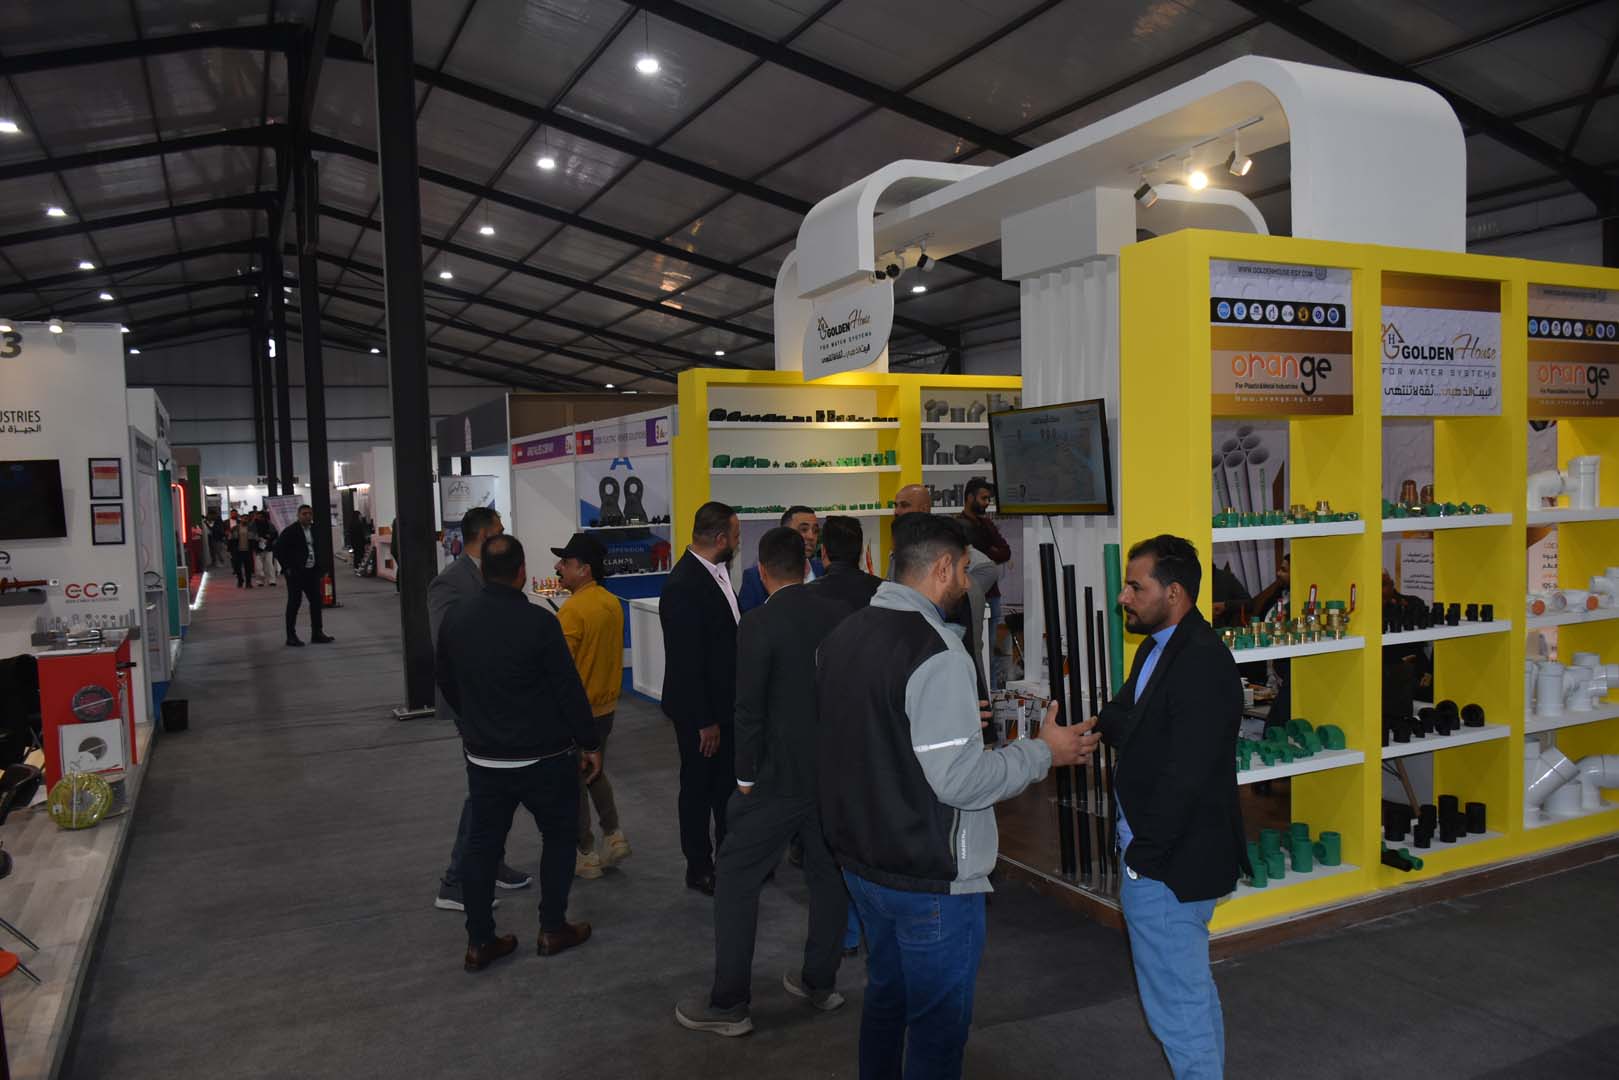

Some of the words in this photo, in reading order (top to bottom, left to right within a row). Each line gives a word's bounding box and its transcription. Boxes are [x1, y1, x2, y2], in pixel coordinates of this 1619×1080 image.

[826, 323, 850, 338] GOLDEN
[1401, 345, 1454, 360] GOLDEN
[1453, 333, 1496, 360] House
[1231, 352, 1332, 396] orange
[1381, 367, 1403, 376] FOR
[1409, 368, 1444, 377] WATER
[1450, 368, 1497, 379] SYSTEMS
[1538, 364, 1610, 399] orange
